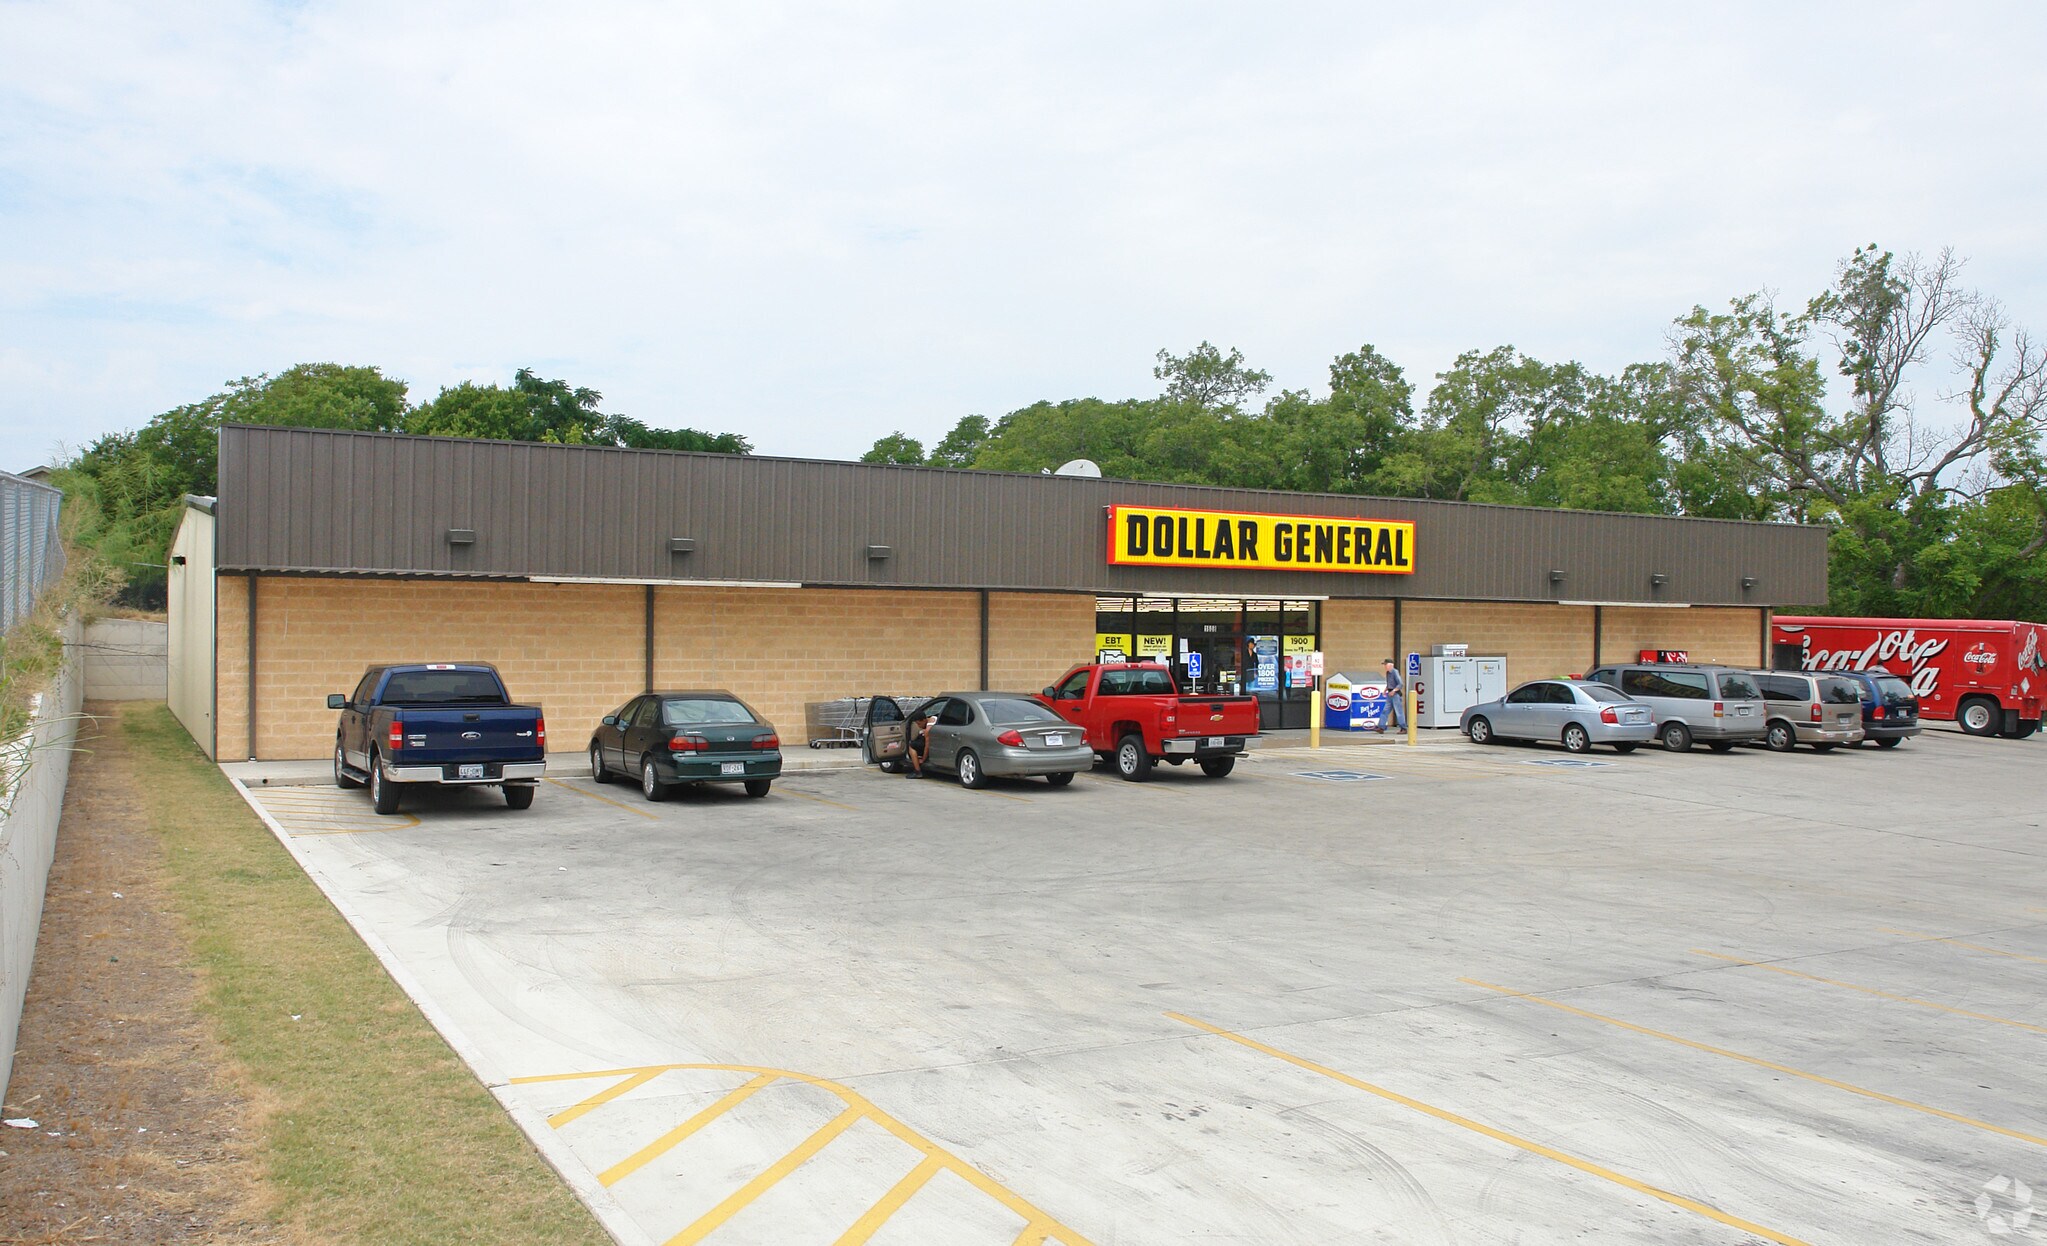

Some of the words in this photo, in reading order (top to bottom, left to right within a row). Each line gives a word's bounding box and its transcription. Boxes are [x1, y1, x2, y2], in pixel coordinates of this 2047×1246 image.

[1127, 514, 1258, 561] DOLLAR
[1274, 523, 1408, 566] GENERAL
[1105, 636, 1122, 644] EBT
[1143, 637, 1167, 645] NEW!
[1290, 637, 1308, 645] 1900
